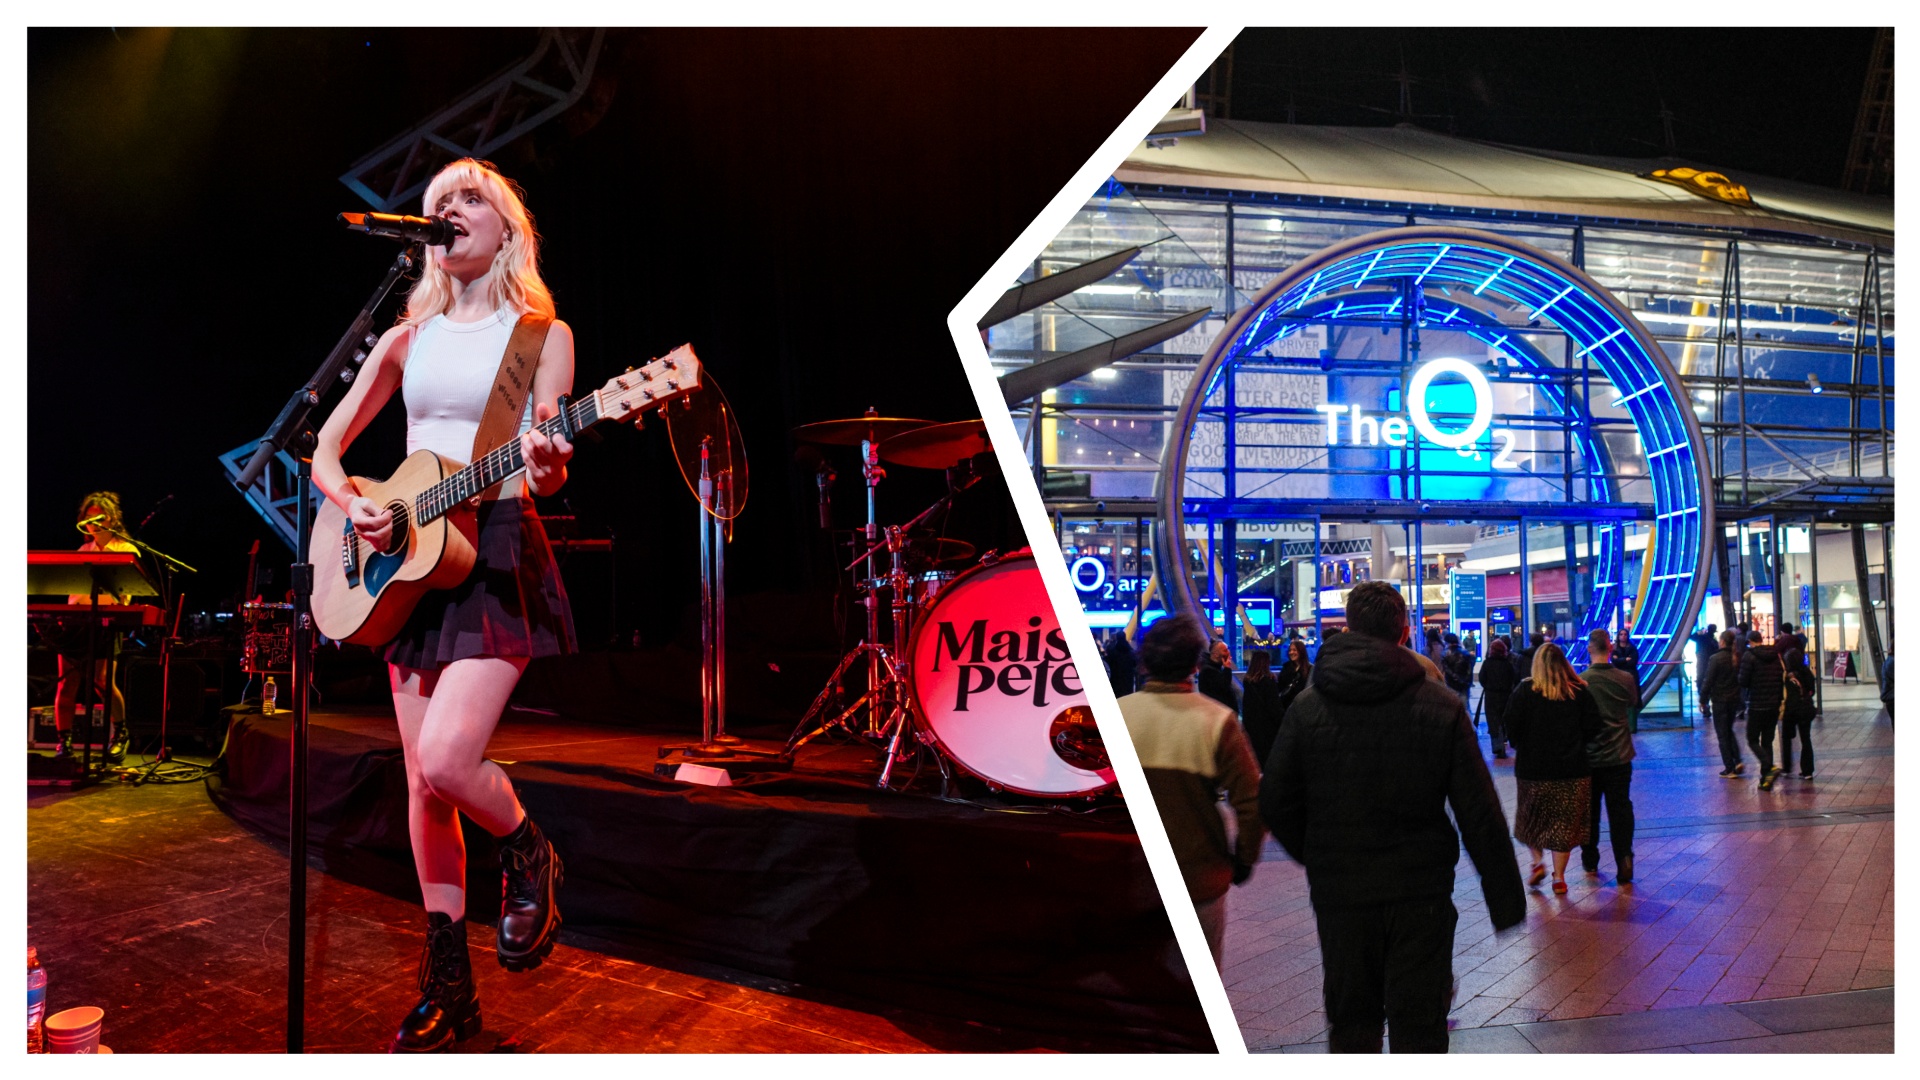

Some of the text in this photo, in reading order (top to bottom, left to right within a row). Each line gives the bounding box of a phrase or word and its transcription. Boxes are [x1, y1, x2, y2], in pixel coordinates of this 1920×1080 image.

[514, 352, 526, 369] THE
[506, 366, 522, 389] GOOD
[497, 384, 517, 412] WITCH
[1213, 391, 1274, 403] BTTER
[1280, 392, 1320, 404] PACE
[1315, 357, 1518, 469] The O2
[1190, 445, 1319, 460] GOO MEMORY
[1070, 556, 1115, 600] O2
